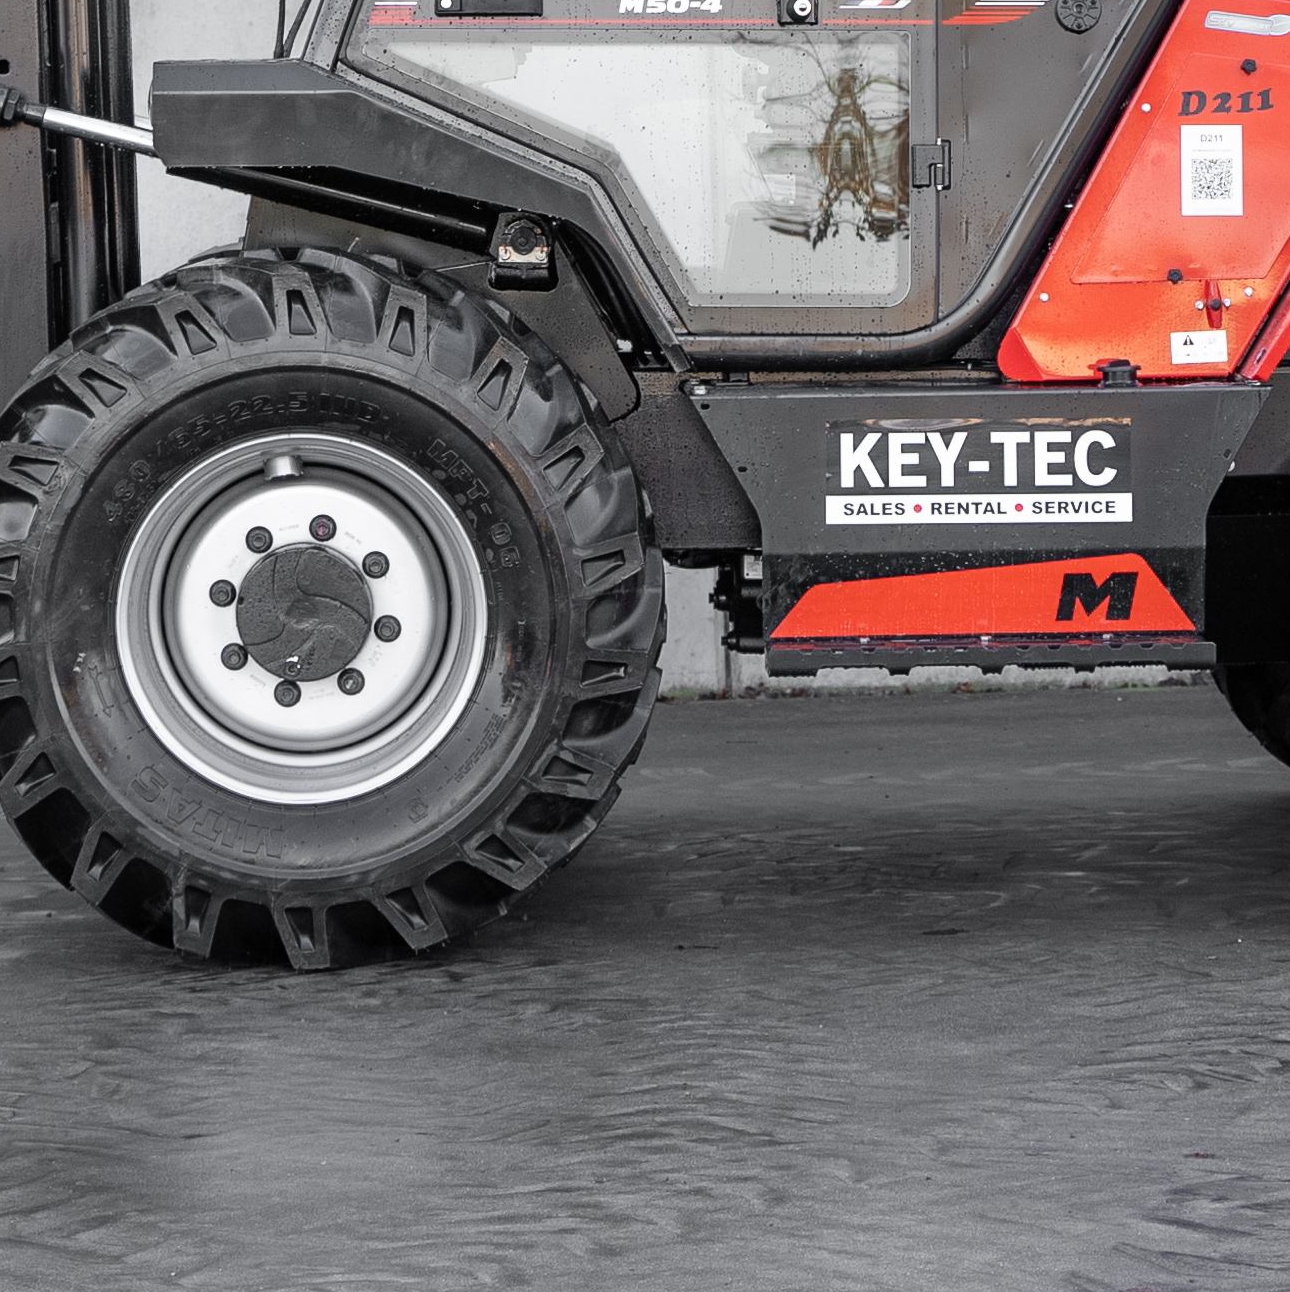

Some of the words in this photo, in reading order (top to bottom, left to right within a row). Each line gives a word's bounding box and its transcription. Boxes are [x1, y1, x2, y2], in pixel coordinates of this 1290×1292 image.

[1178, 88, 1274, 116] D211
[1200, 134, 1223, 142] D211
[840, 429, 1118, 488] KEY-TEC
[843, 502, 905, 516] SALES
[931, 502, 1007, 515] RENTAL
[1032, 501, 1116, 515] SERVICE
[129, 765, 284, 857] MITAS
